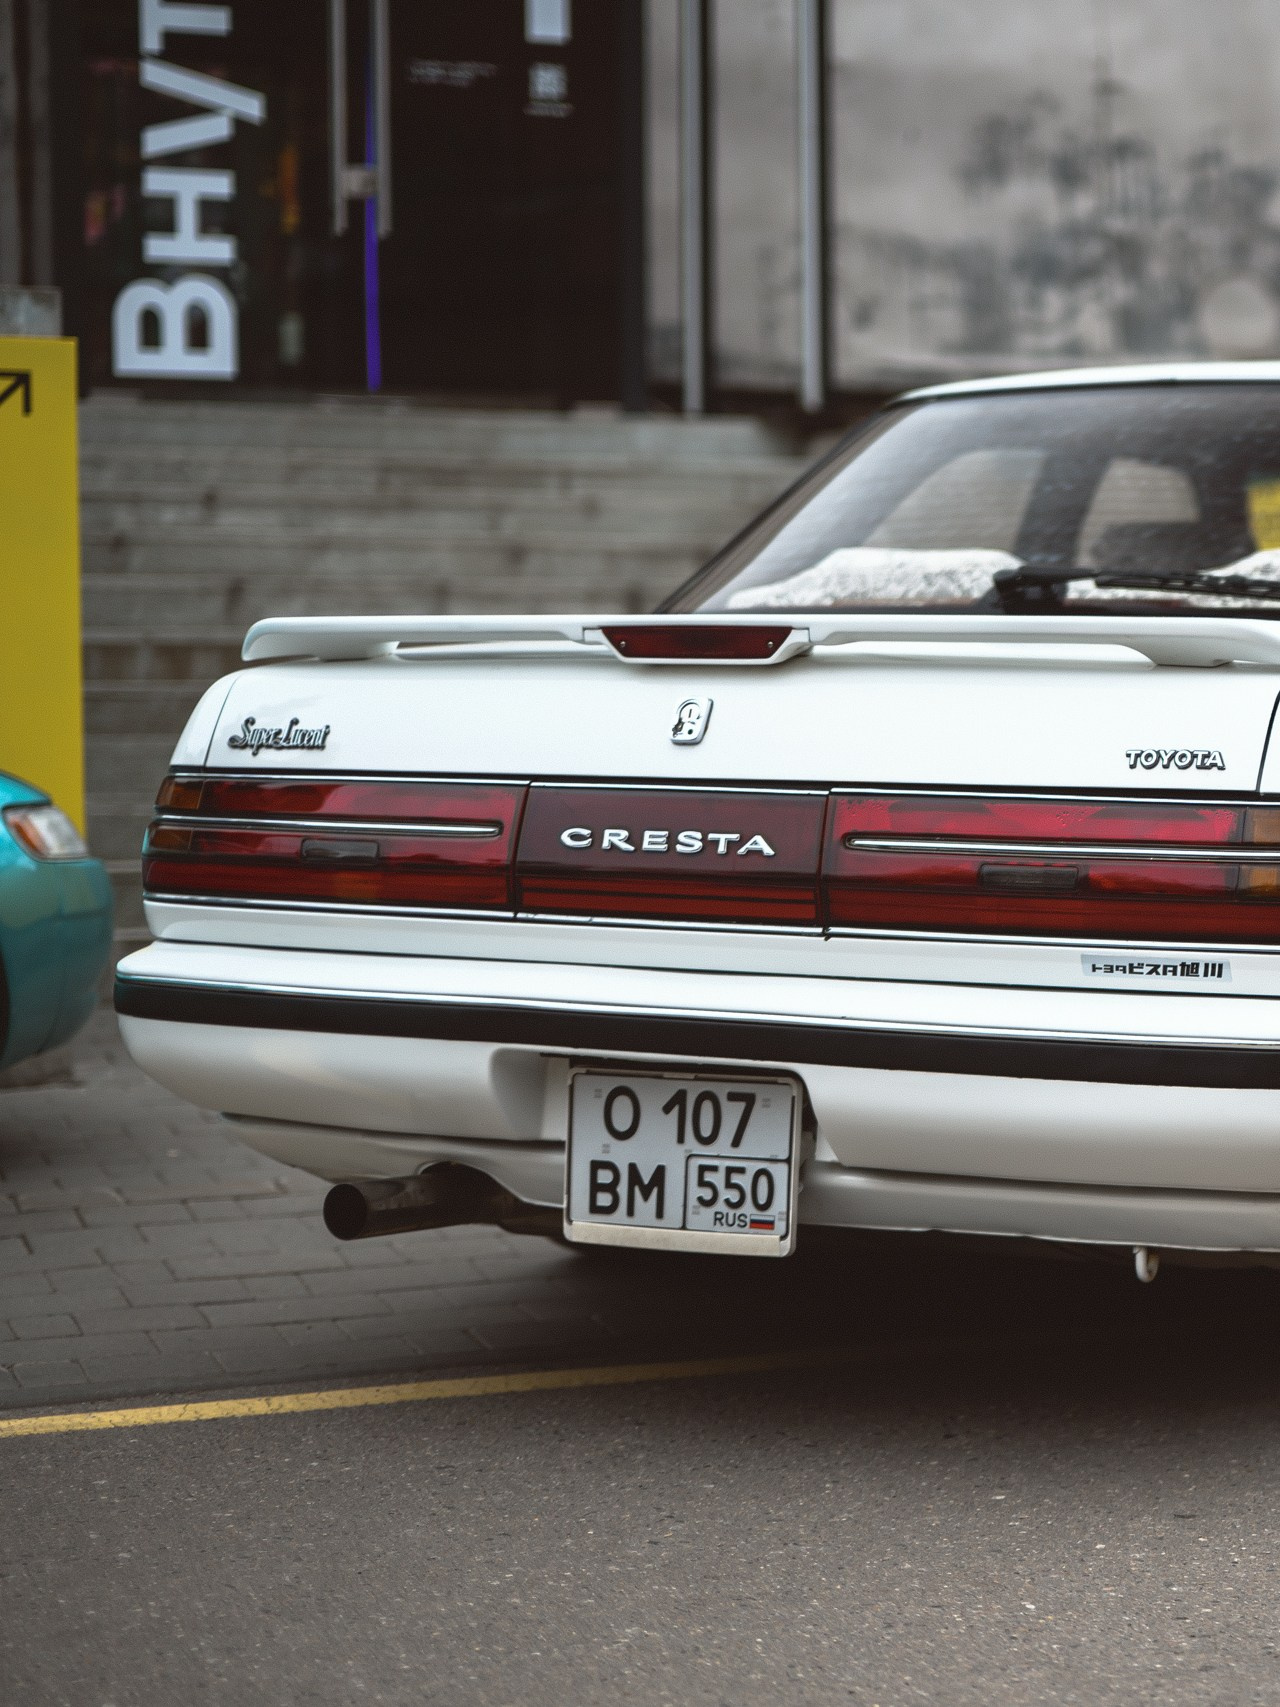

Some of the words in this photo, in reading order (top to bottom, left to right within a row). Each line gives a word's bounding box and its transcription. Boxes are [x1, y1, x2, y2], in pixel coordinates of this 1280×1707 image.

[1126, 749, 1226, 770] TOYOTA
[560, 827, 775, 856] CRESTA
[662, 1089, 756, 1148] 107
[697, 1163, 775, 1211] 550
[713, 1210, 748, 1228] RUS
